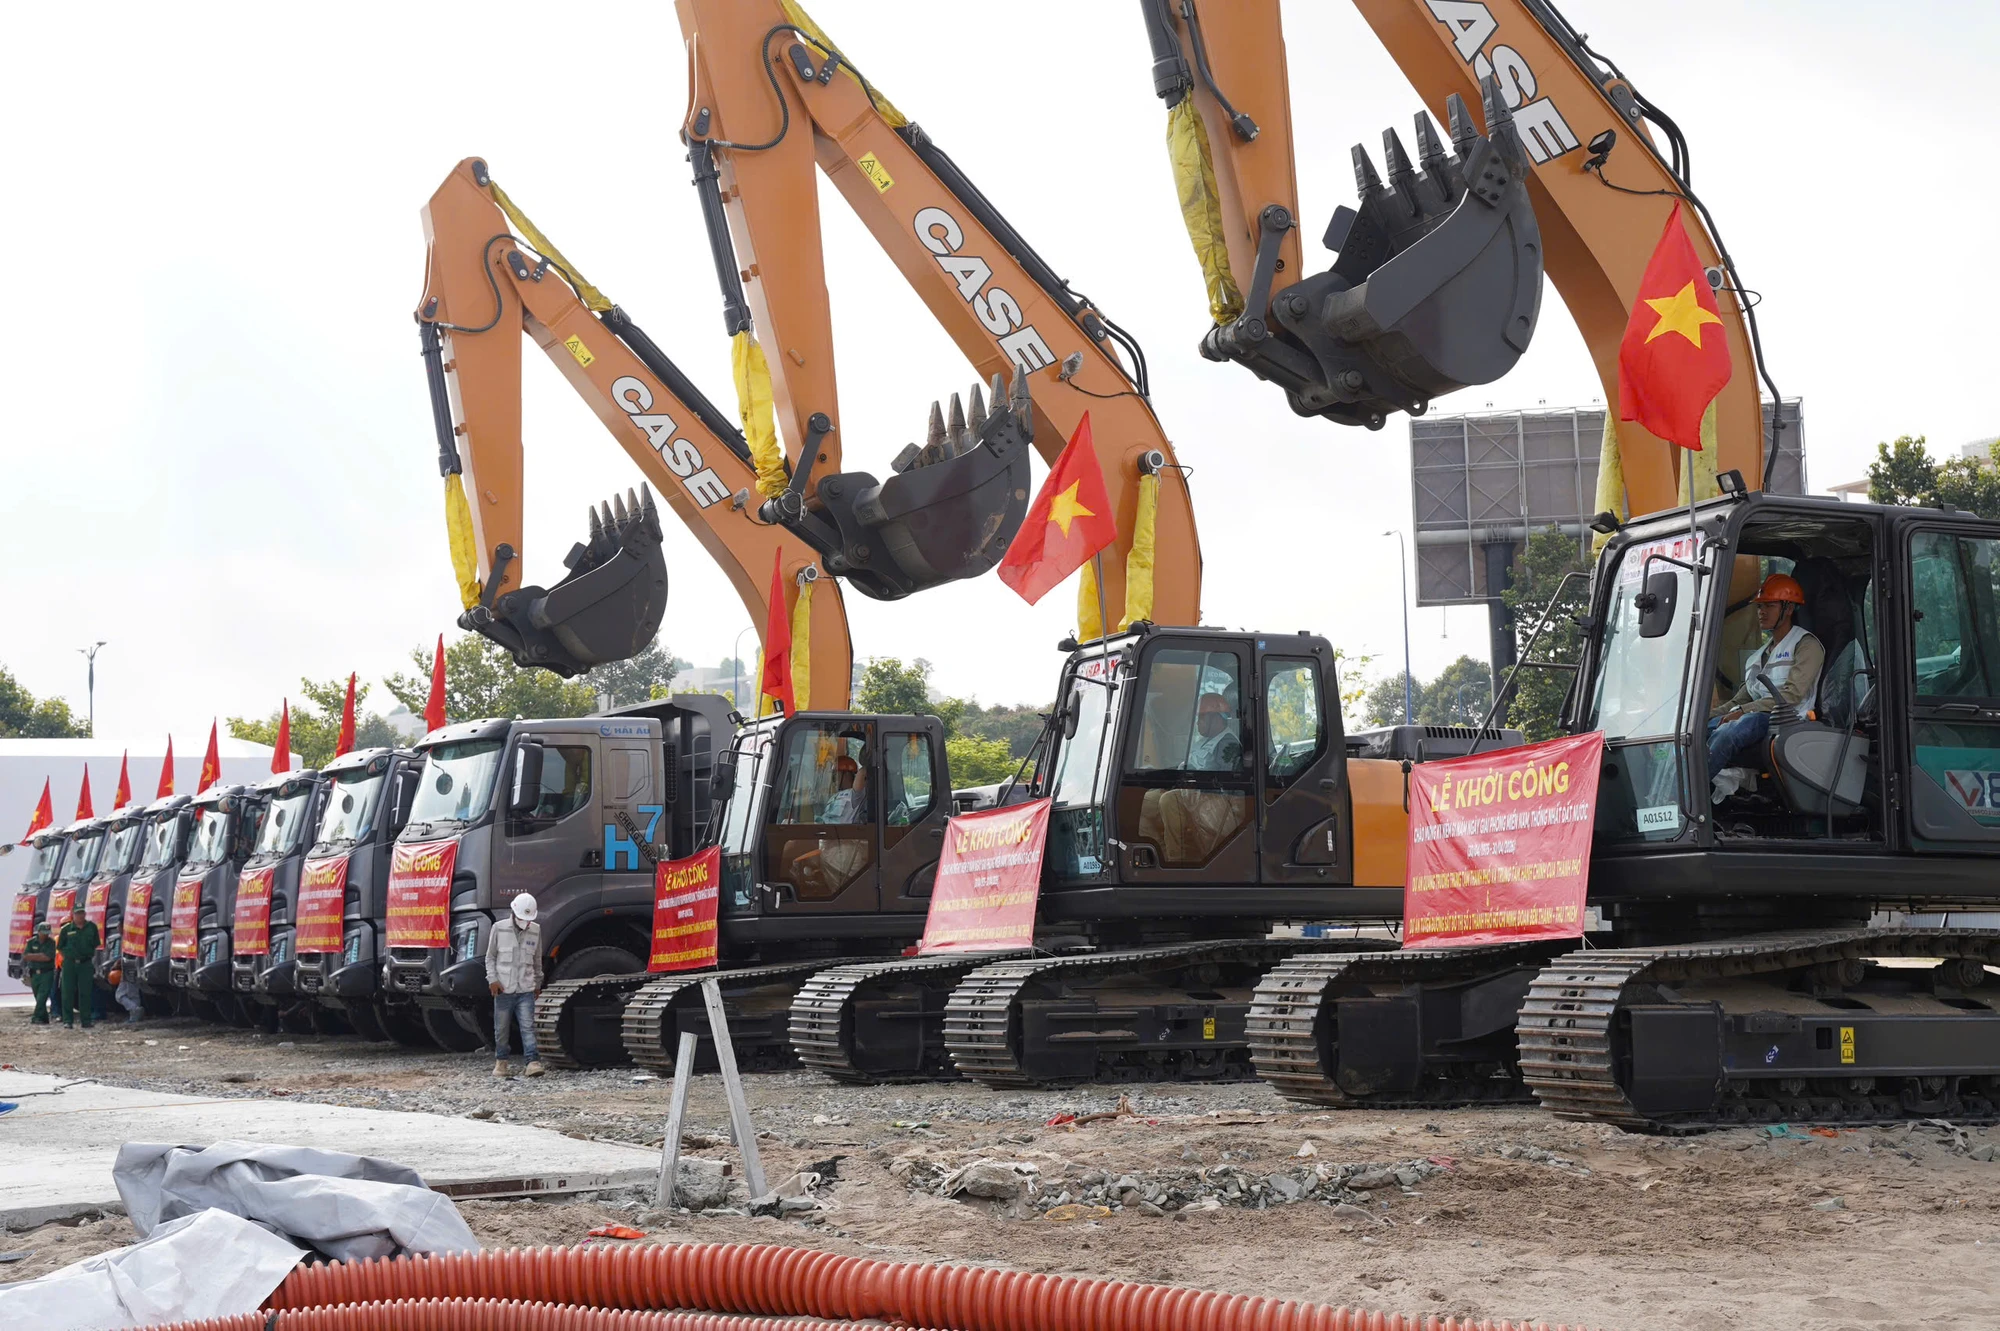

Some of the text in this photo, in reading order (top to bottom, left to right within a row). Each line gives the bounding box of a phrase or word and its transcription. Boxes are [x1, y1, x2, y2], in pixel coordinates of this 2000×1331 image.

[913, 206, 1057, 376] CASE
[611, 375, 732, 509] CASE
[1430, 760, 1569, 812] LỄ KHỞI CÔNG
[618, 812, 640, 840] CHENG
[1530, 803, 1548, 827] THỐNG
[1547, 801, 1562, 824] NHẤT
[1644, 811, 1672, 824] A01512
[998, 818, 1032, 846] CÔNG
[688, 862, 708, 885] CÔNG
